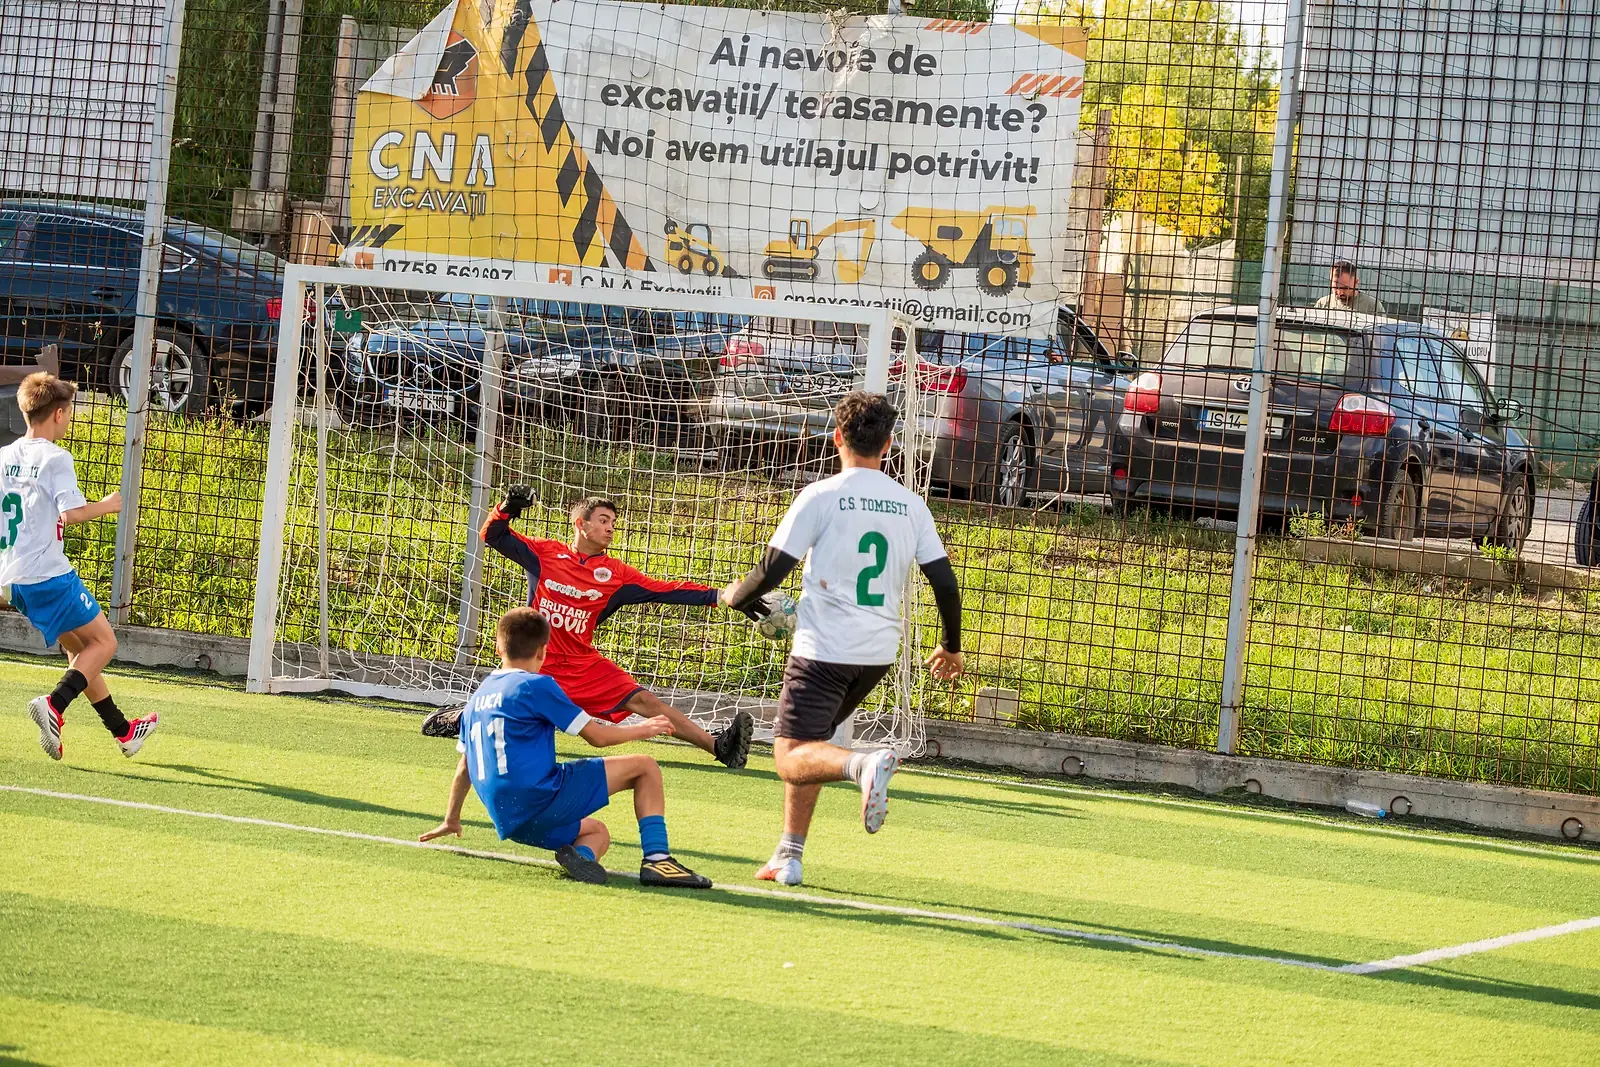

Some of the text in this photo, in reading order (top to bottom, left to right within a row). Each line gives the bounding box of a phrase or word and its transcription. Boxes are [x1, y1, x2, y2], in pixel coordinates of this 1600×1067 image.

[709, 34, 938, 77] Ai nevoie de
[785, 90, 1048, 134] terasamente?
[594, 128, 1040, 184] Noi avem utilajul potrivit!
[1210, 412, 1241, 429] IS 14
[1298, 435, 1326, 444] AURIS
[0, 492, 23, 549] 3
[839, 497, 908, 516] C.S. TOMESTI
[856, 531, 889, 607] 2
[80, 592, 92, 610] 2
[474, 692, 503, 712] LUCA
[470, 717, 508, 780] 11
